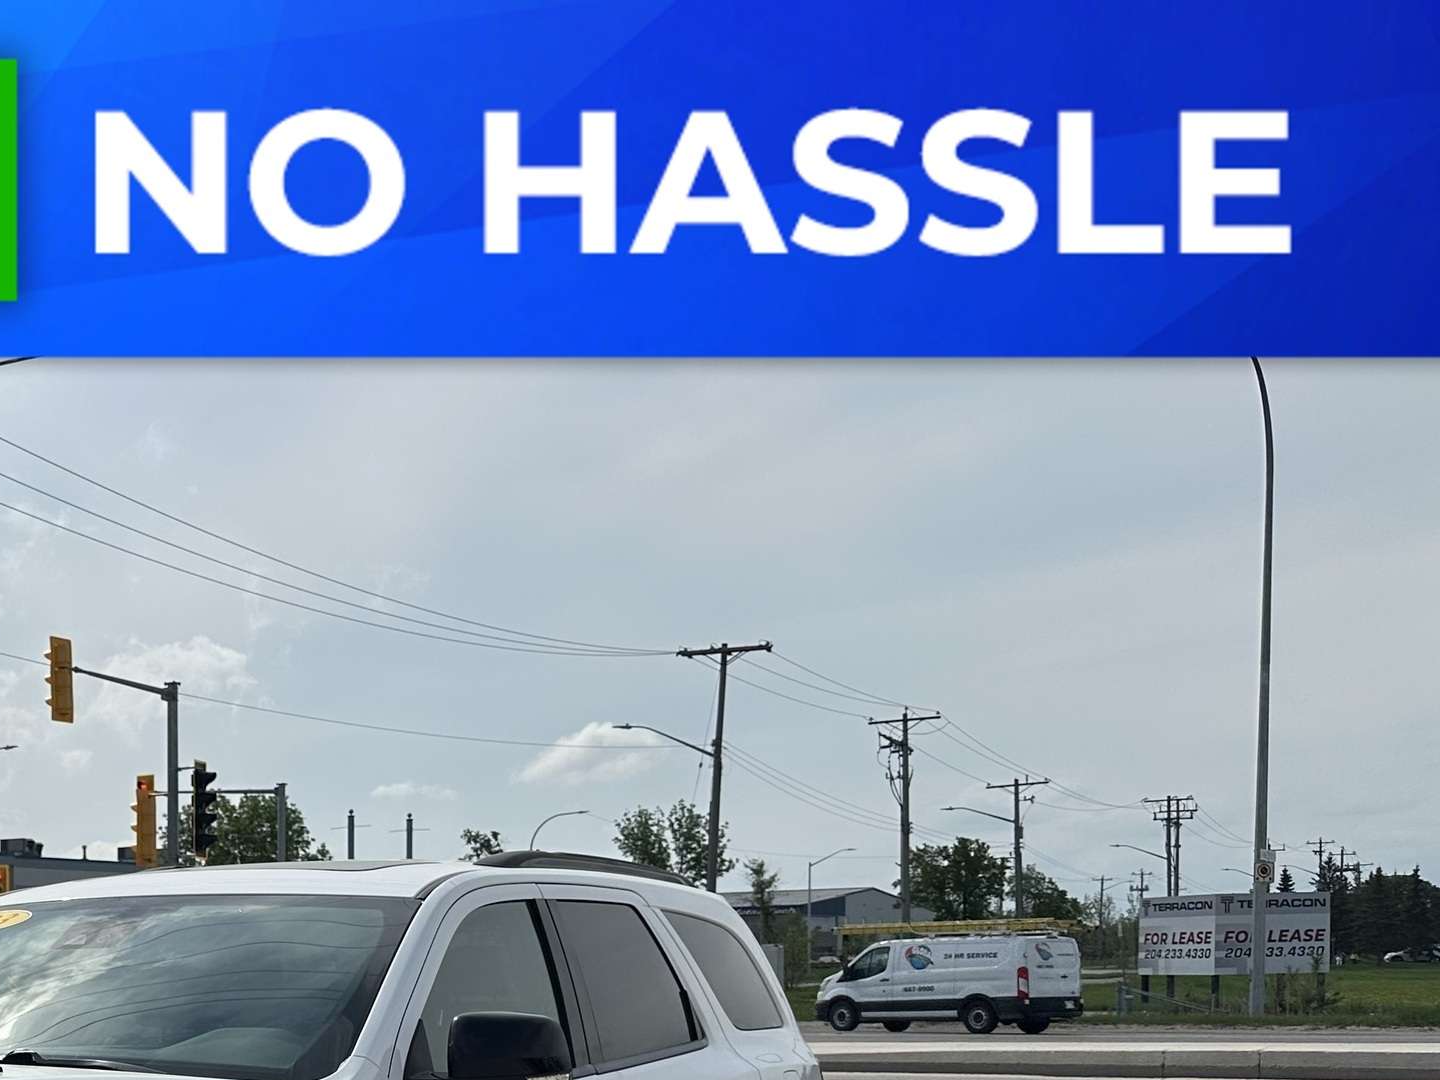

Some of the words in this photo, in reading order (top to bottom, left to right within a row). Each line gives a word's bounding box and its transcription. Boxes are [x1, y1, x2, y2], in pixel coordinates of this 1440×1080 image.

[1152, 900, 1213, 913] TERRACON
[1237, 898, 1327, 909] TERACON
[1144, 932, 1168, 945] FOR
[1171, 931, 1213, 945] LEASE
[1223, 930, 1253, 944] FO
[1266, 928, 1327, 943] LEASE
[966, 951, 998, 960] SERVICE
[1144, 948, 1212, 960] 204.233.4330
